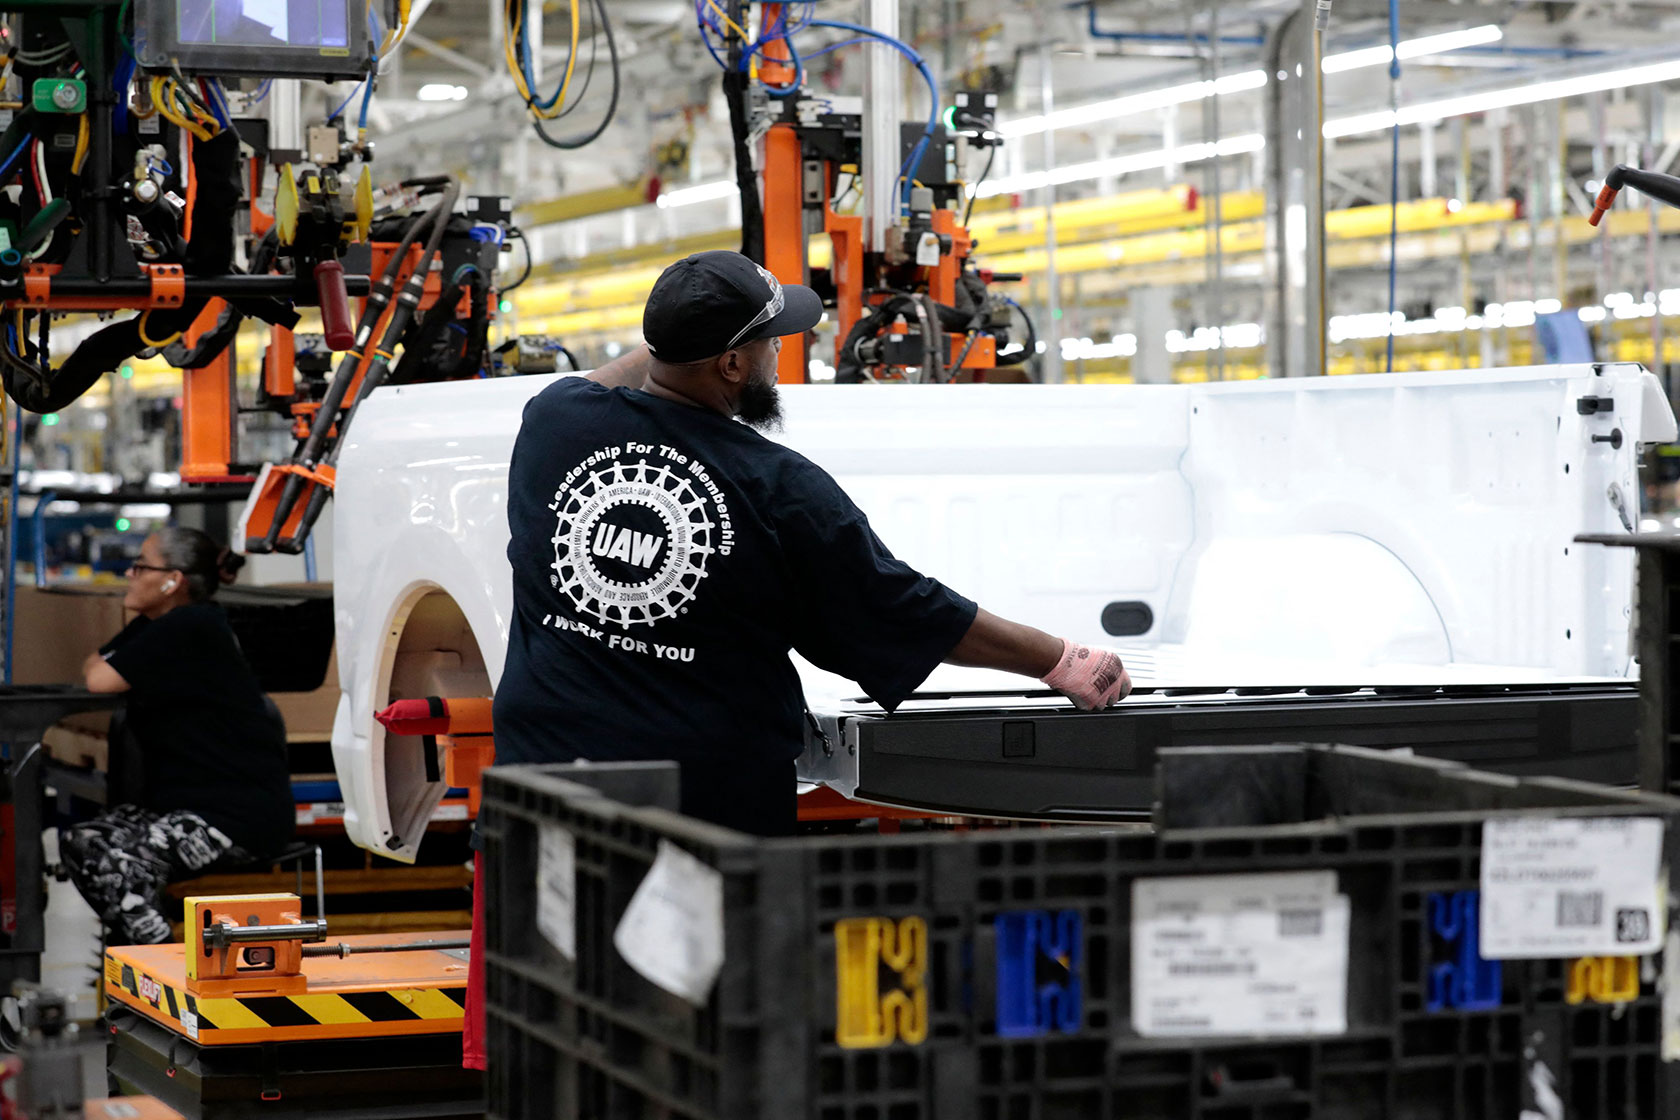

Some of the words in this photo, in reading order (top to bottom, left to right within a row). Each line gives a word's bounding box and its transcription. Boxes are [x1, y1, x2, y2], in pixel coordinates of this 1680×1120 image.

[548, 446, 621, 511] Leadership
[626, 441, 654, 454] For
[659, 444, 688, 465] The
[687, 460, 735, 556] Membership
[592, 522, 664, 569] UAW
[608, 634, 649, 654] FOR
[653, 643, 695, 662] YOU
